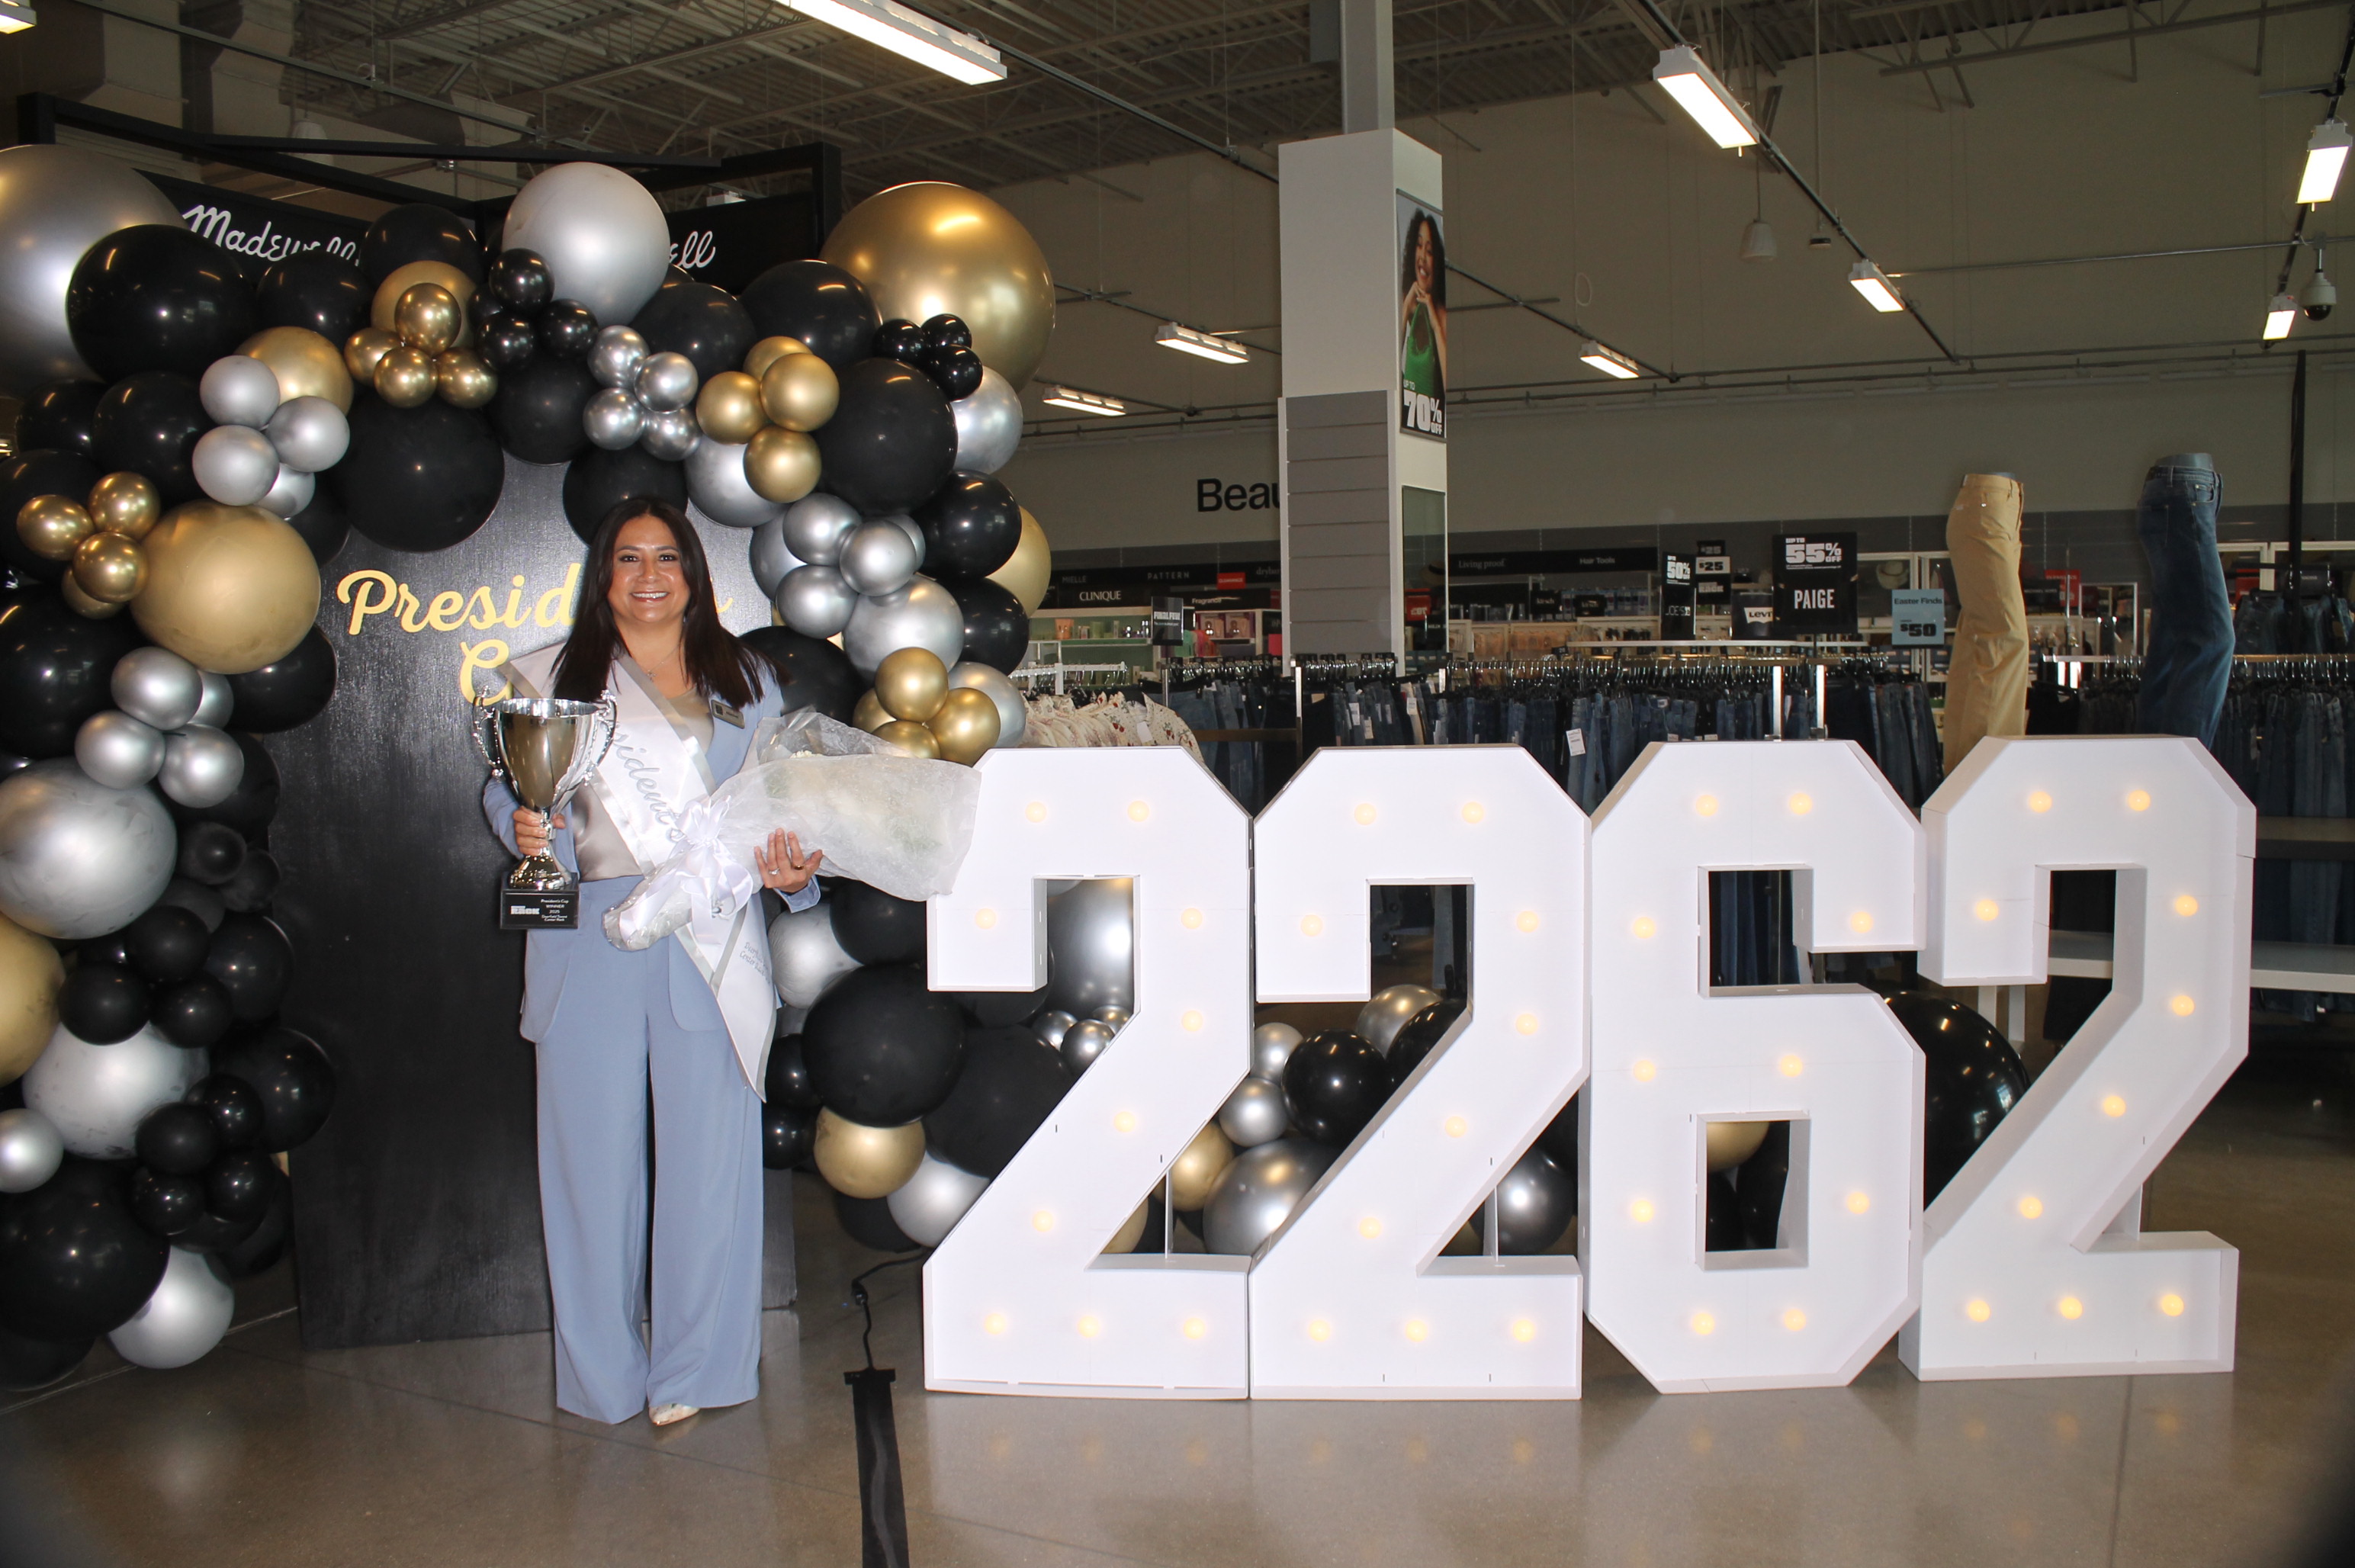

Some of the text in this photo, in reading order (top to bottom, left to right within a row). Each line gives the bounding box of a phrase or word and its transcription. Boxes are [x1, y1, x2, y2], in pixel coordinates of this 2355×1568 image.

[1403, 389, 1442, 432] 70%
[1431, 422, 1442, 435] OFF
[1785, 542, 1842, 564] 55%
[1458, 560, 1482, 570] Living
[1698, 561, 1724, 571] $25
[1147, 572, 1190, 580] PATTERN
[1079, 590, 1122, 602] CLINIQUE
[1794, 589, 1835, 609] PAIGE
[1900, 623, 1937, 638] $50
